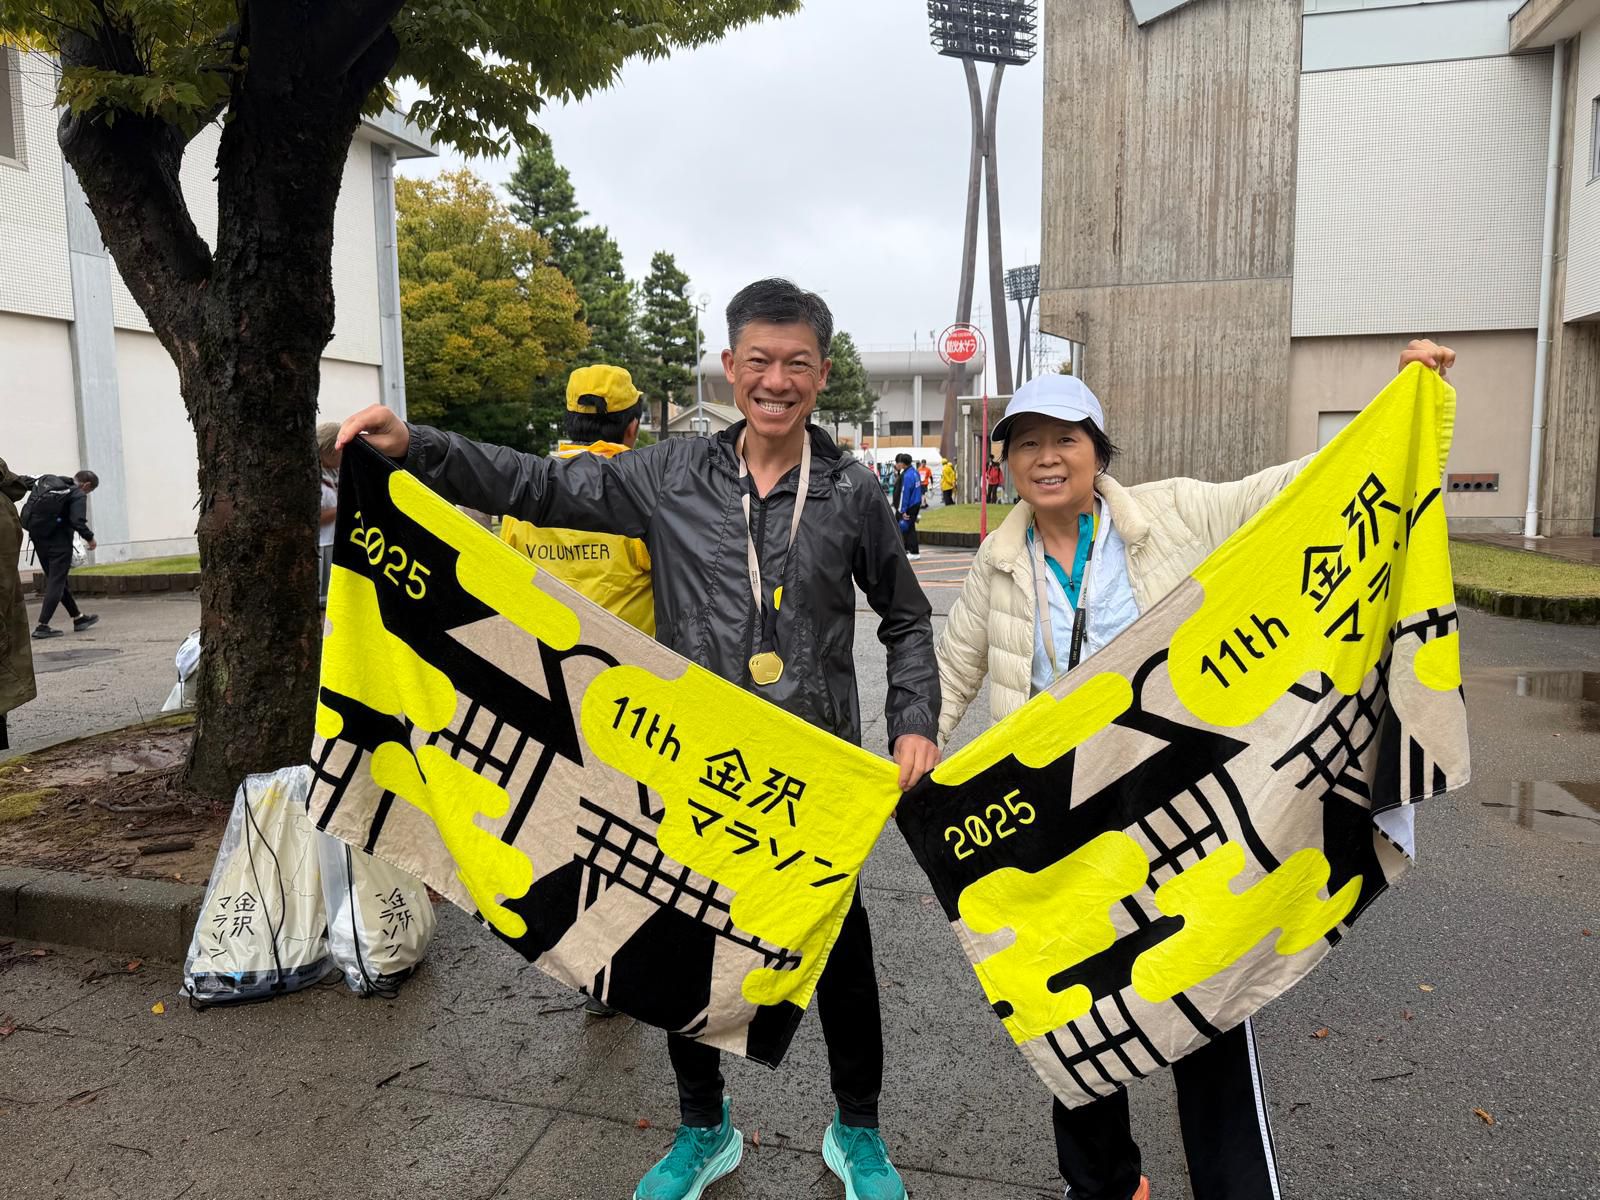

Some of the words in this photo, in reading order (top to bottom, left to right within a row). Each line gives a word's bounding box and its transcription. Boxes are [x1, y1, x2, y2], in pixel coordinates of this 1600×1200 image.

[350, 511, 431, 600] 2025
[525, 543, 610, 560] VOLUNTEER
[1201, 613, 1290, 688] 11th
[1301, 472, 1401, 613] 金沢
[612, 696, 681, 762] 11th
[699, 748, 807, 827] 金沢
[688, 798, 850, 888] マラソン
[944, 788, 1036, 860] 2025
[209, 895, 233, 960] マラソン
[229, 891, 258, 937] 金沢
